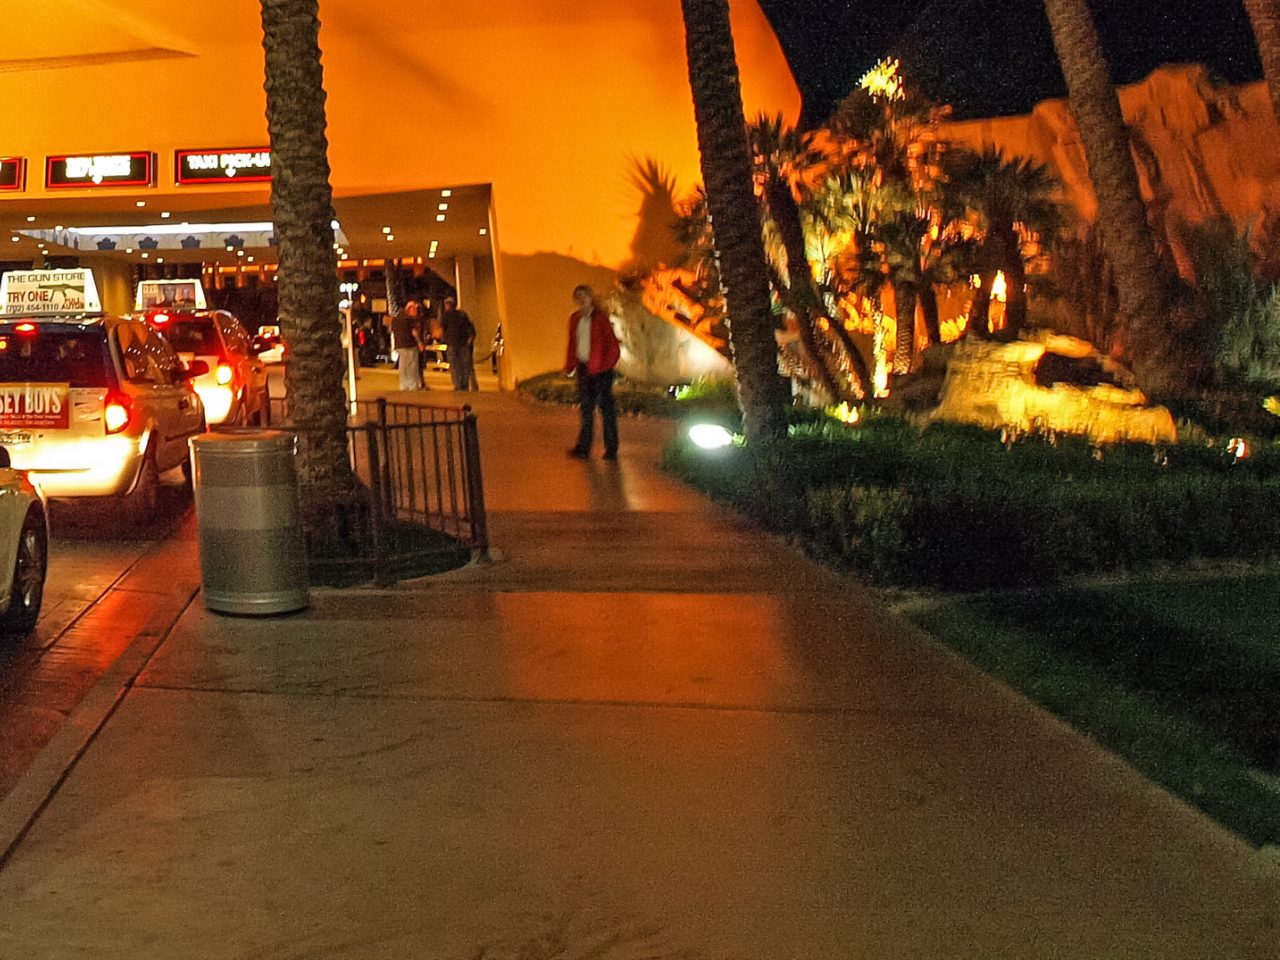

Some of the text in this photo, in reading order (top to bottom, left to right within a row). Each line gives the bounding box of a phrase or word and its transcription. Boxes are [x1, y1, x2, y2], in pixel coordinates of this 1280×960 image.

[187, 154, 218, 169] TAXI
[7, 272, 85, 283] THE GUN STORE
[7, 291, 26, 303] TRY
[25, 386, 62, 414] BOYS
